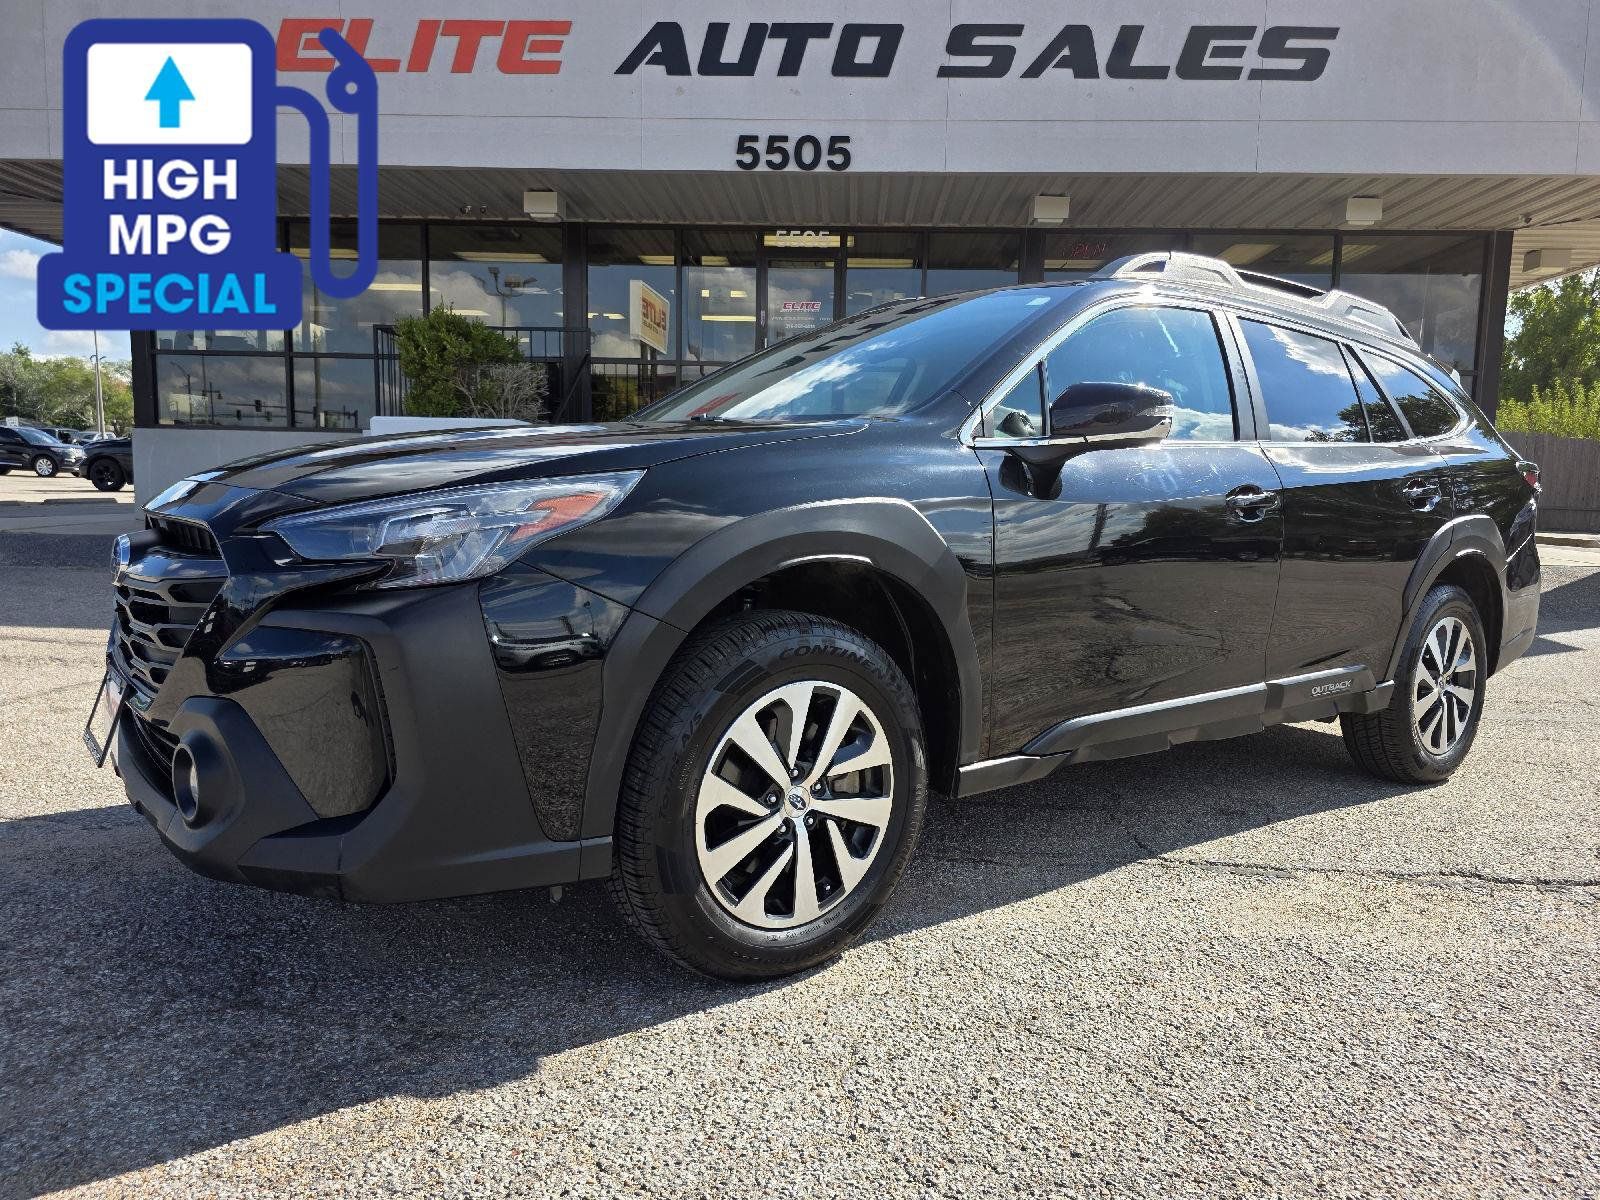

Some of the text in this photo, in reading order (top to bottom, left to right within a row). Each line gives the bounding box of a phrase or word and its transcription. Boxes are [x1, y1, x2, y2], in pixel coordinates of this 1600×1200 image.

[275, 18, 1340, 81] ELITE AUTO SALES
[735, 135, 852, 172] 5505
[775, 230, 830, 248] 5505
[782, 302, 821, 311] ELITE
[1311, 679, 1352, 695] OUTBACK
